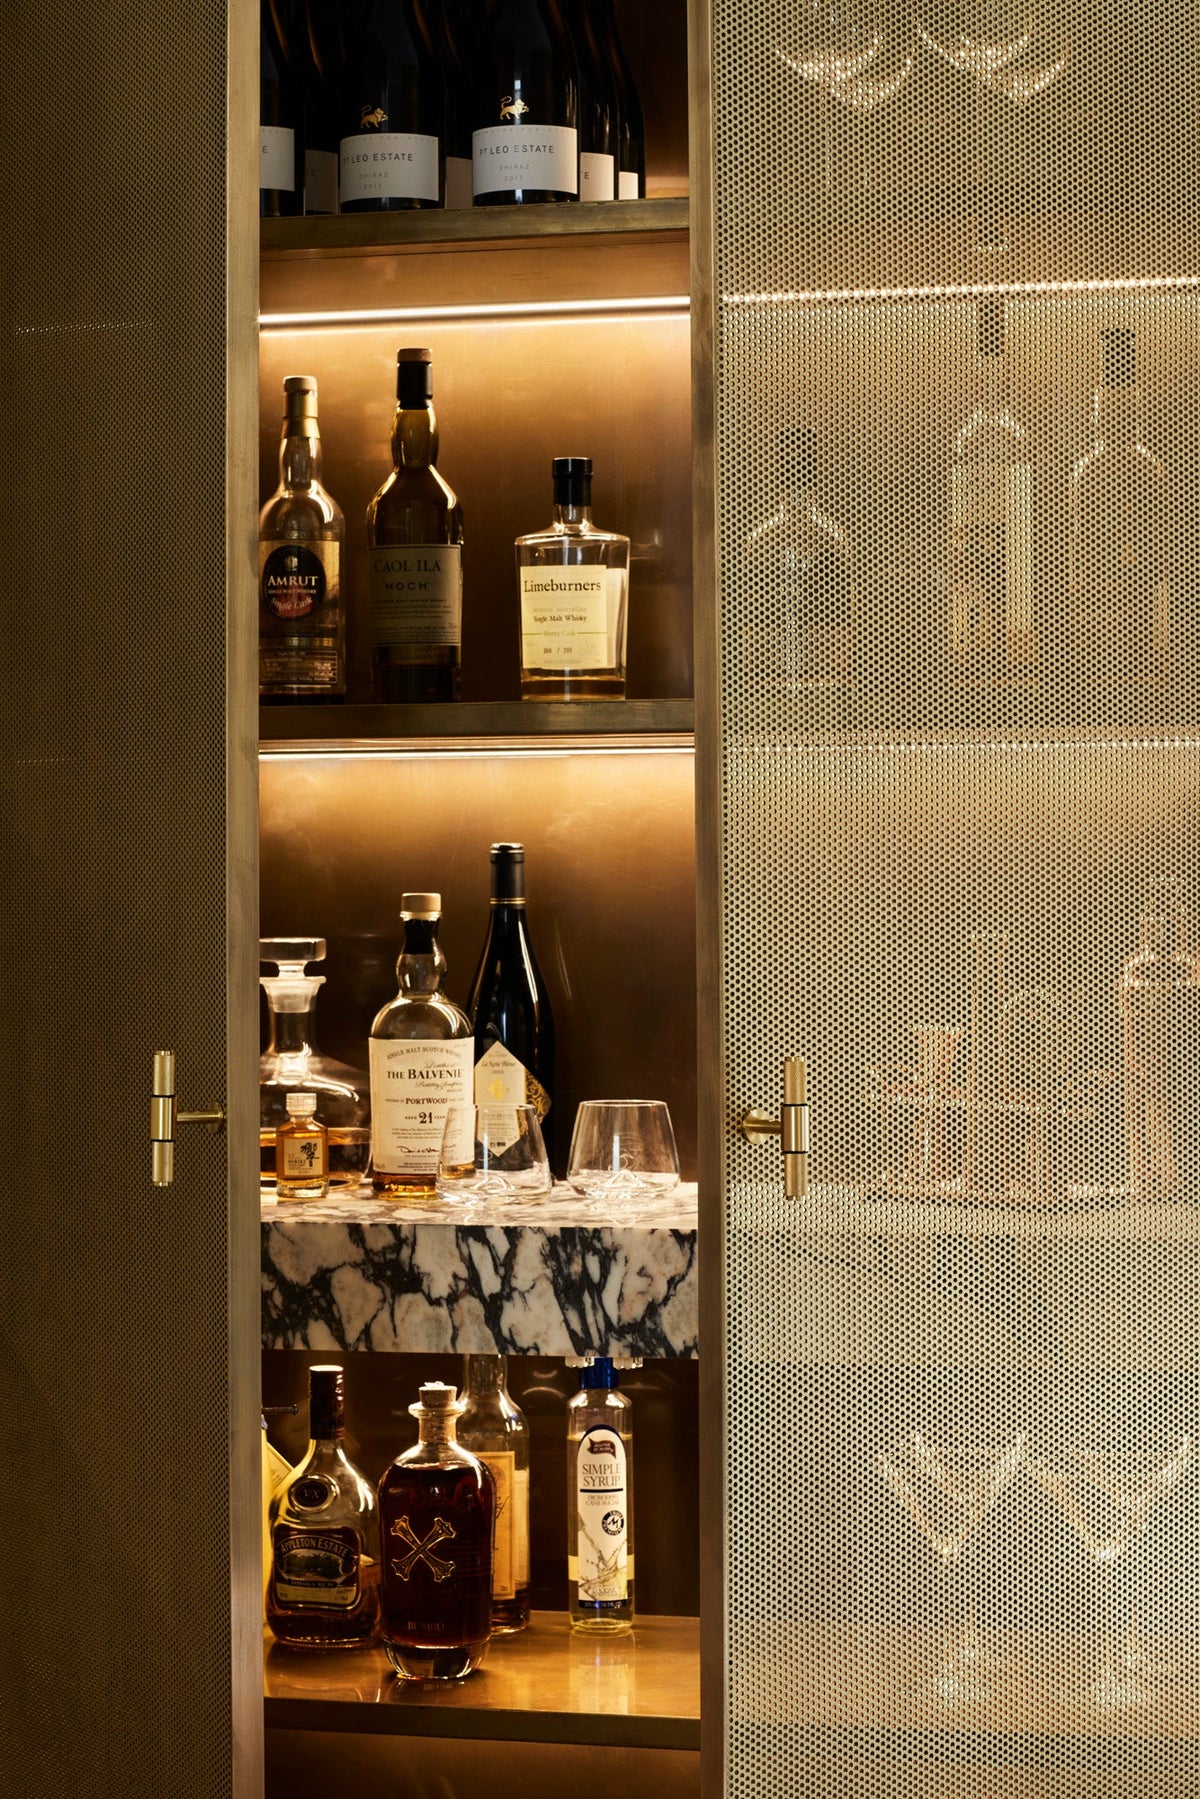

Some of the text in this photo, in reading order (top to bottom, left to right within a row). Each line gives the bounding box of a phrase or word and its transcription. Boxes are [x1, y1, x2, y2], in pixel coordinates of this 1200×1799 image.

[490, 145, 509, 155] LEO
[513, 144, 555, 154] ESTATE
[351, 154, 369, 164] LEO
[372, 153, 414, 163] ESTATE
[375, 559, 441, 574] CAOL ILA
[267, 575, 319, 587] AMRUT
[385, 582, 428, 591] MOCH
[523, 579, 602, 593] Limeburners
[387, 1068, 462, 1080] THE BALVENIE
[405, 1097, 448, 1105] PORTWOOD
[419, 1111, 433, 1125] 21
[582, 1463, 622, 1475] SIMPLE
[583, 1475, 621, 1487] SYRUP
[280, 1537, 348, 1557] APPLETON ESTATE
